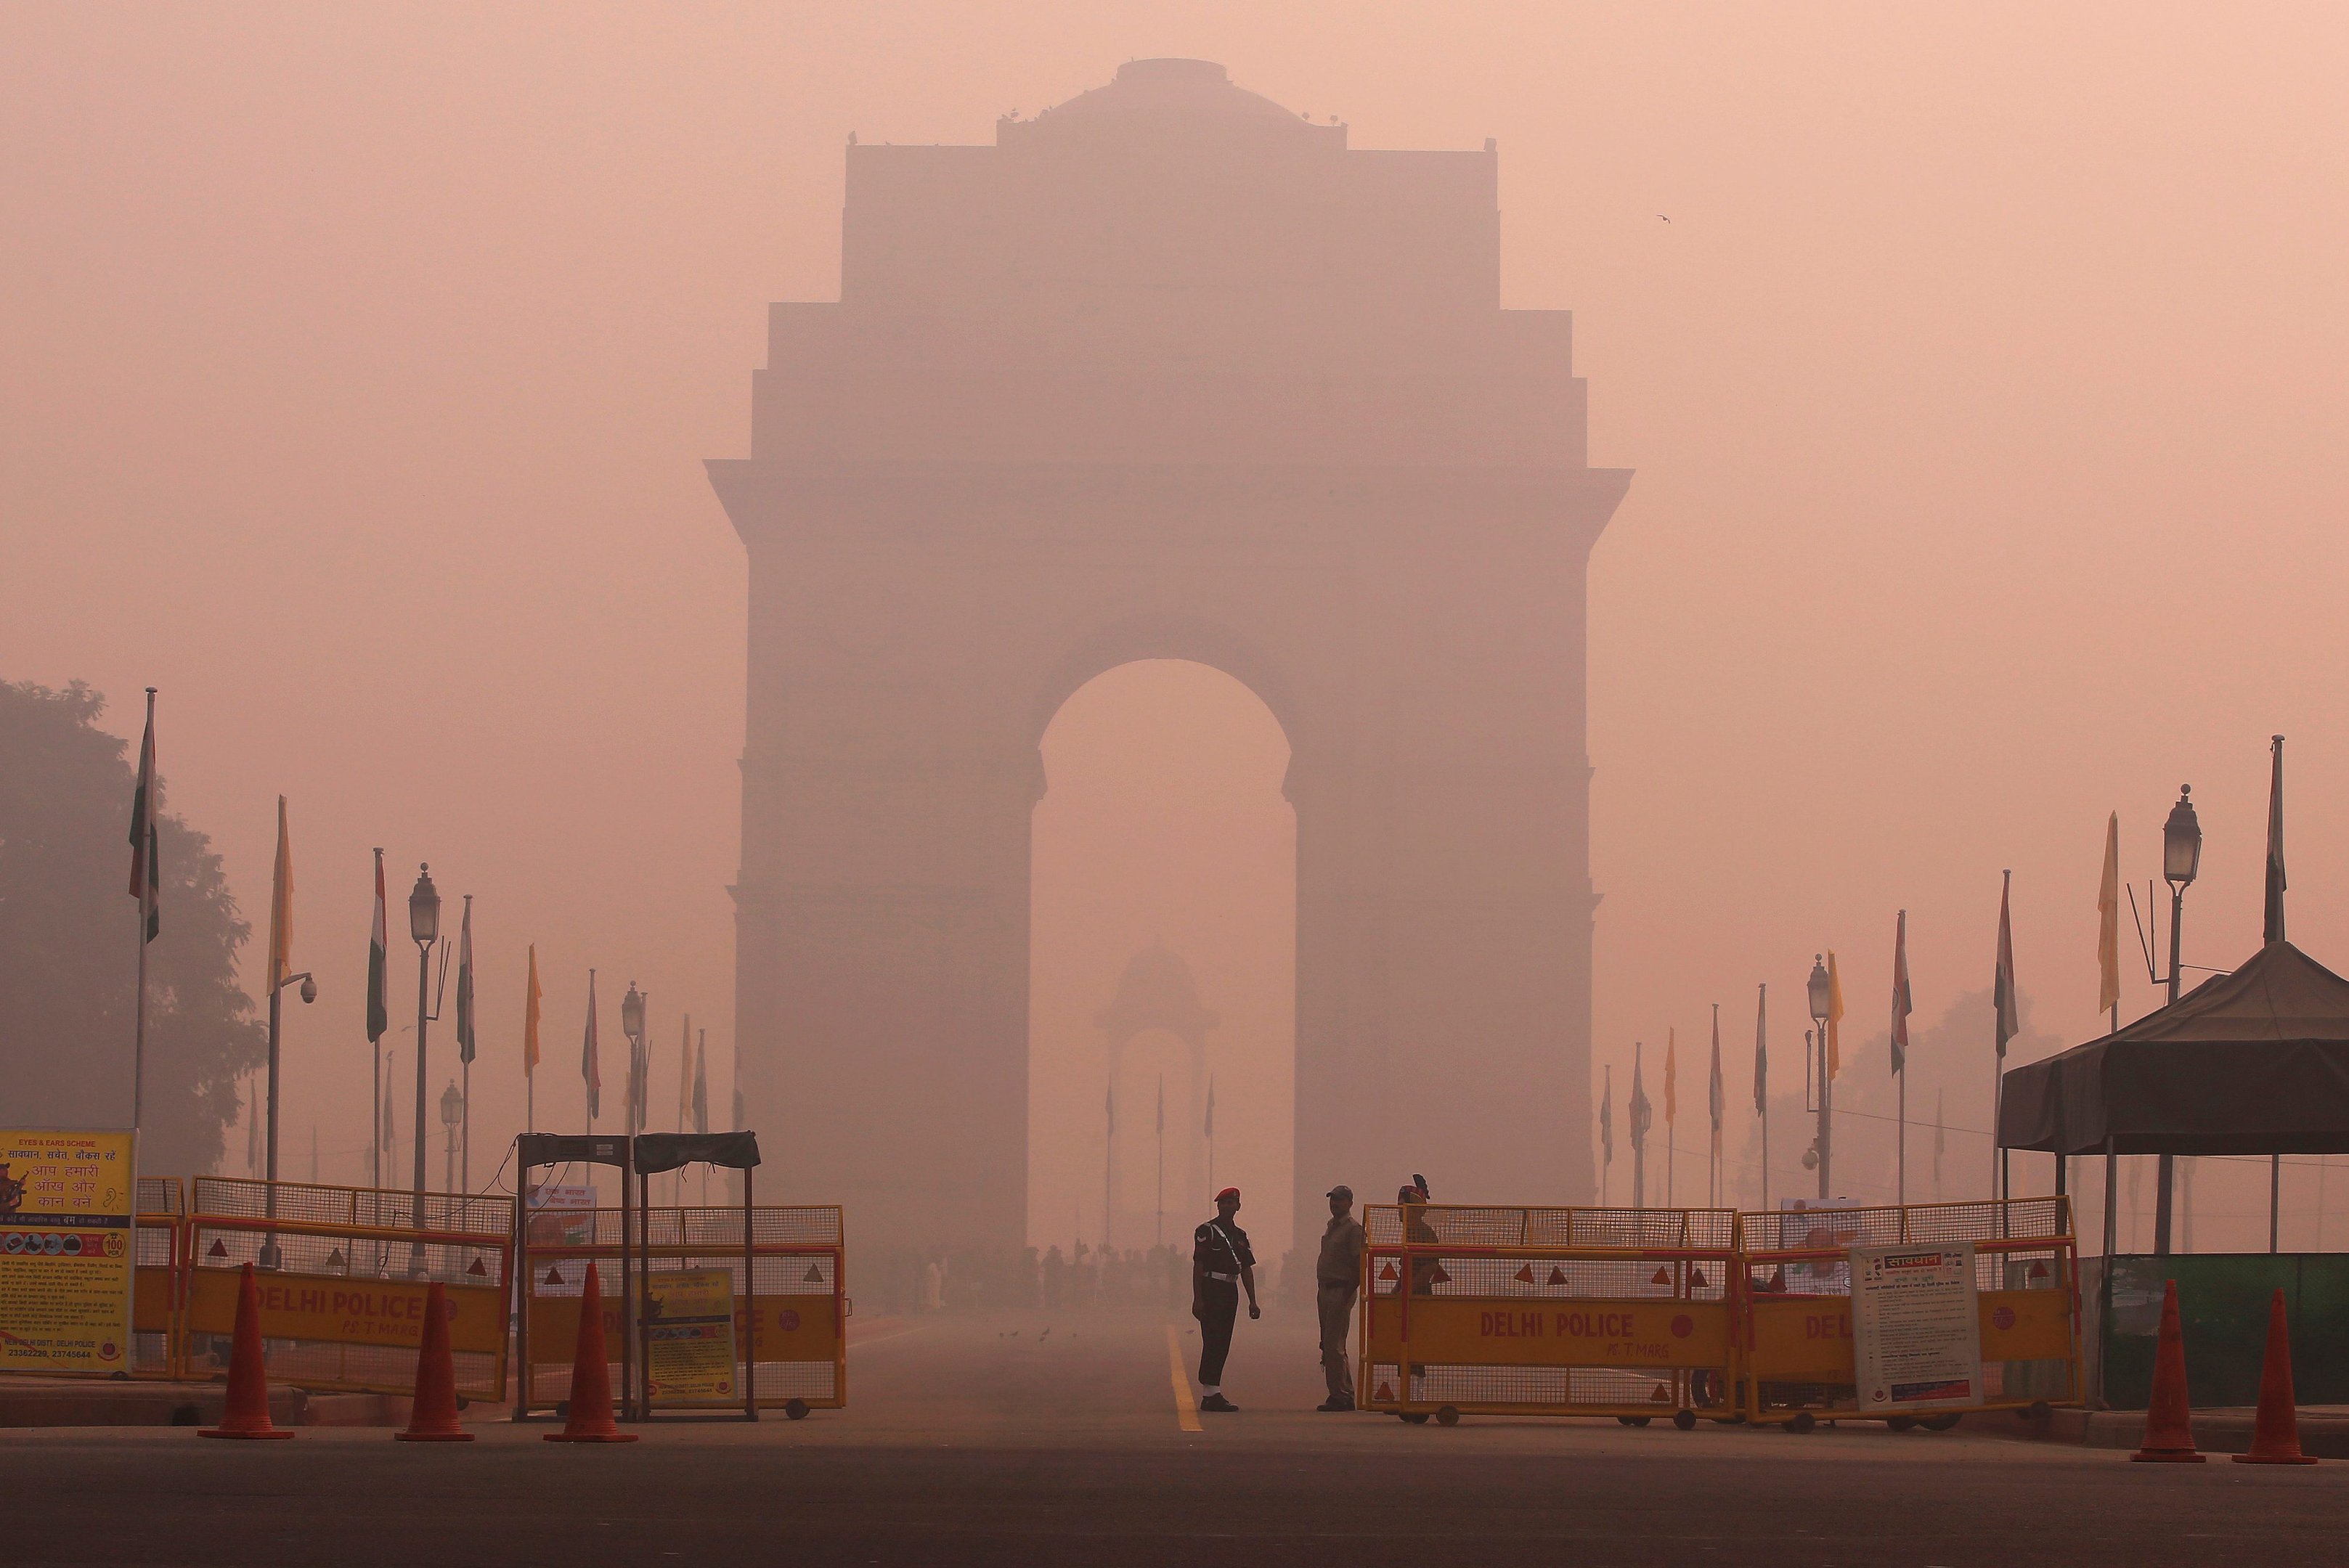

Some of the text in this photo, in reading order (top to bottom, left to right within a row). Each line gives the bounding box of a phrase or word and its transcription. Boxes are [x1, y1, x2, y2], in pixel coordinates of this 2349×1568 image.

[32, 1164, 99, 1177] आप हमारी
[72, 1179, 96, 1192] और
[38, 1195, 91, 1208] कान बनें
[107, 1240, 122, 1250] 100
[1887, 1257, 1939, 1267] सावधान
[333, 1291, 423, 1320] POLICE
[1481, 1312, 1634, 1337] DELHI POLICE
[1806, 1314, 1854, 1339] DEL
